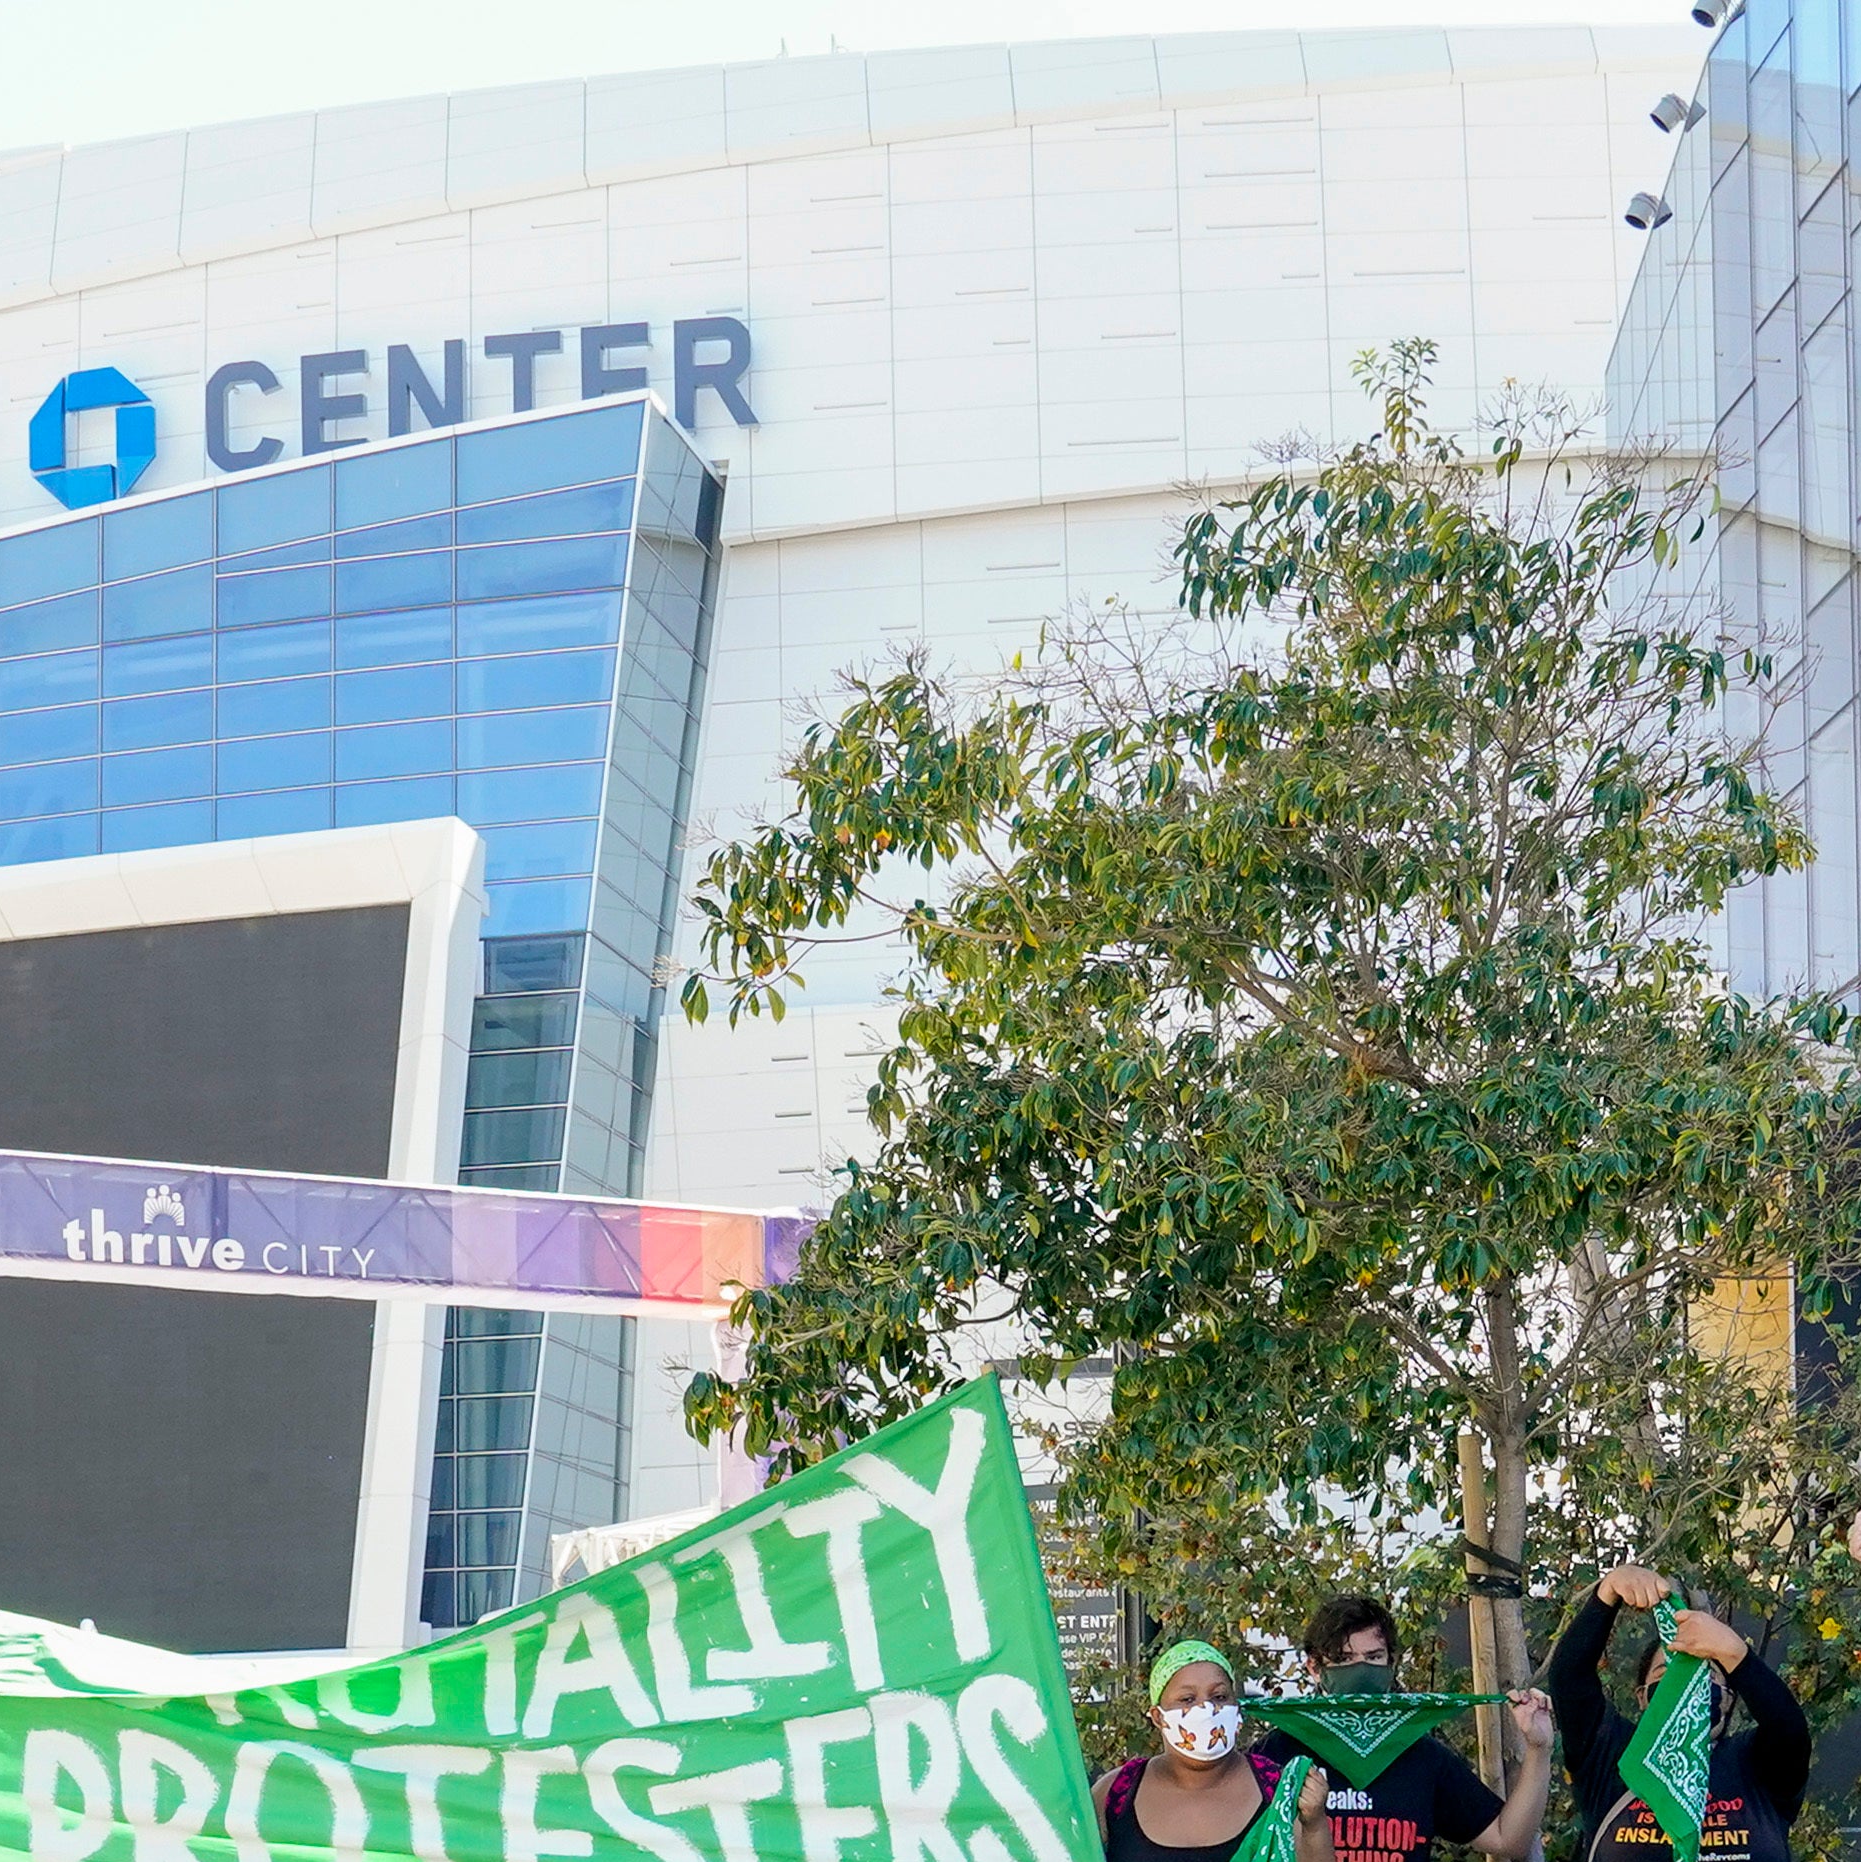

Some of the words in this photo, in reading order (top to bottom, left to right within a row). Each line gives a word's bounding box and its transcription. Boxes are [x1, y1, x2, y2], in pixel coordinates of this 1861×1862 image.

[204, 316, 760, 473] CENTER
[62, 1207, 245, 1272] thrive
[261, 1241, 376, 1280] CITY
